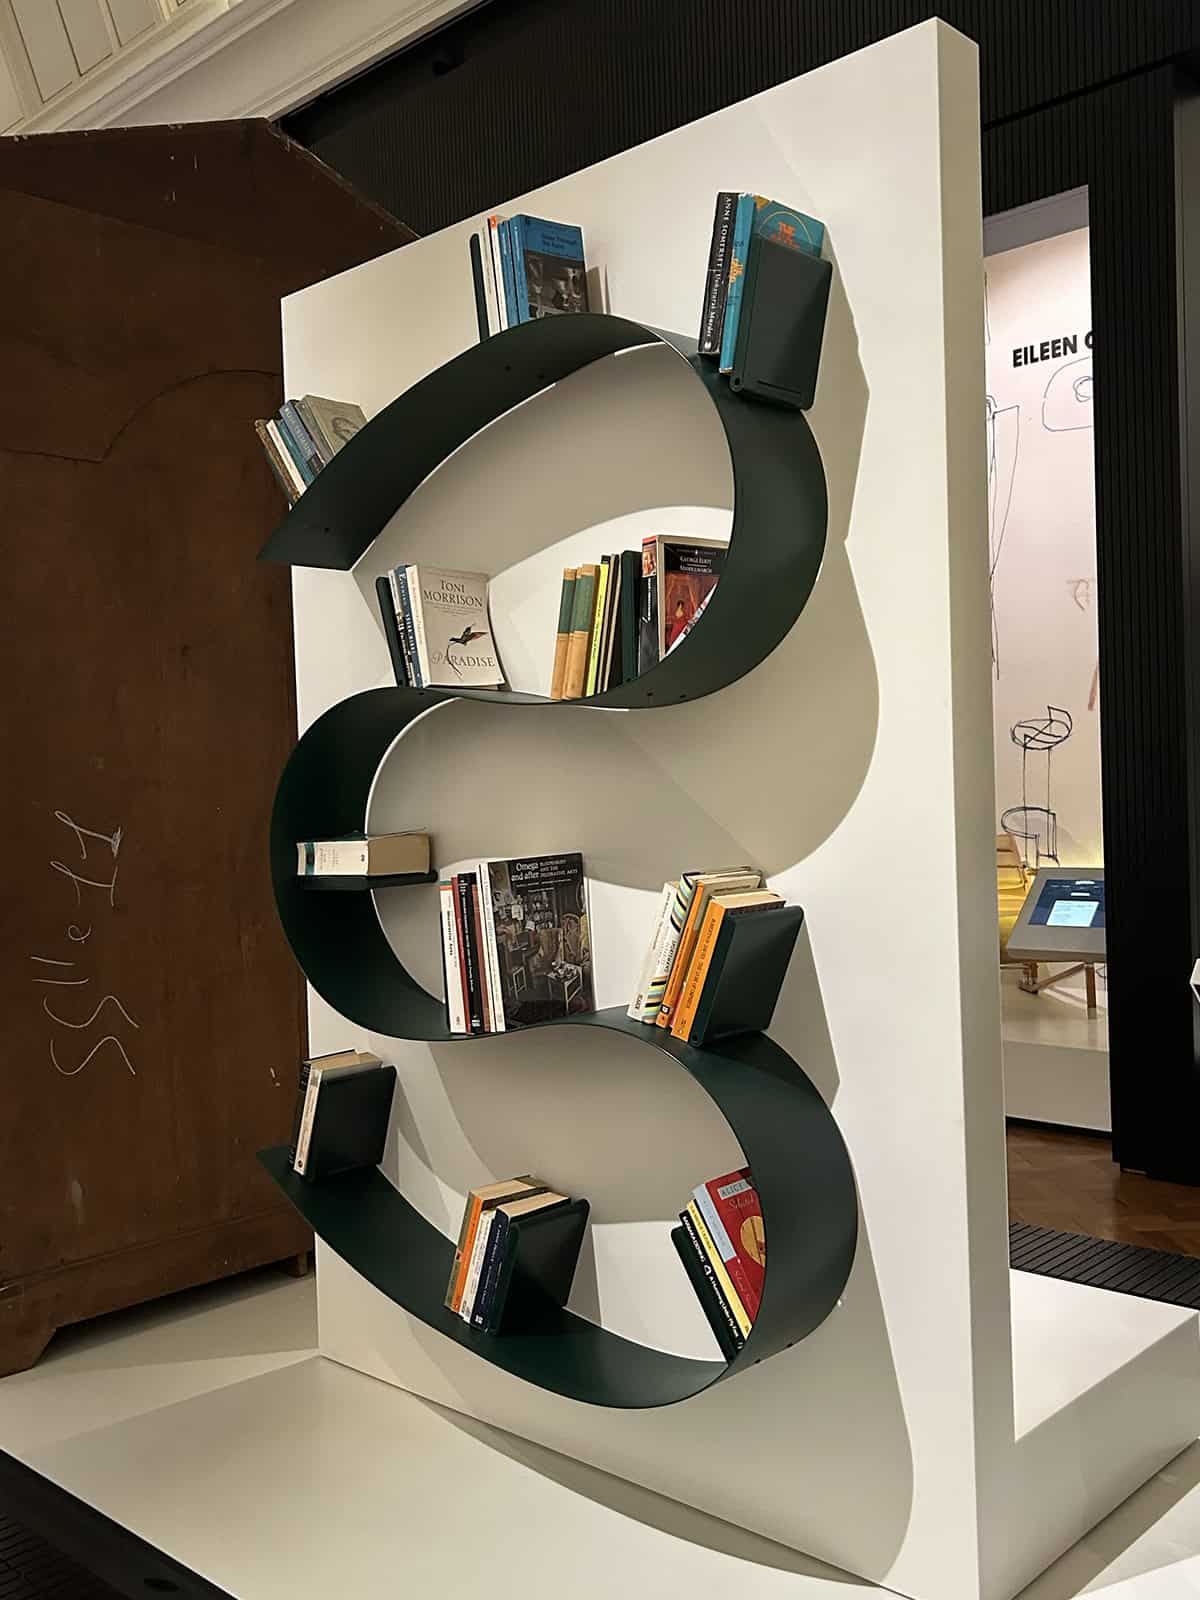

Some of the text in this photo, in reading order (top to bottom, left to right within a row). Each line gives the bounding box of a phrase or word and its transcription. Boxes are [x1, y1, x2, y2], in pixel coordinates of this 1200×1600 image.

[723, 197, 732, 220] ANNE
[1013, 334, 1077, 368] EILEEN
[441, 580, 465, 593] TONI
[423, 590, 482, 607] MORRISON
[431, 650, 495, 667] PARADISE
[516, 862, 539, 871] Omega
[511, 871, 539, 881] and after
